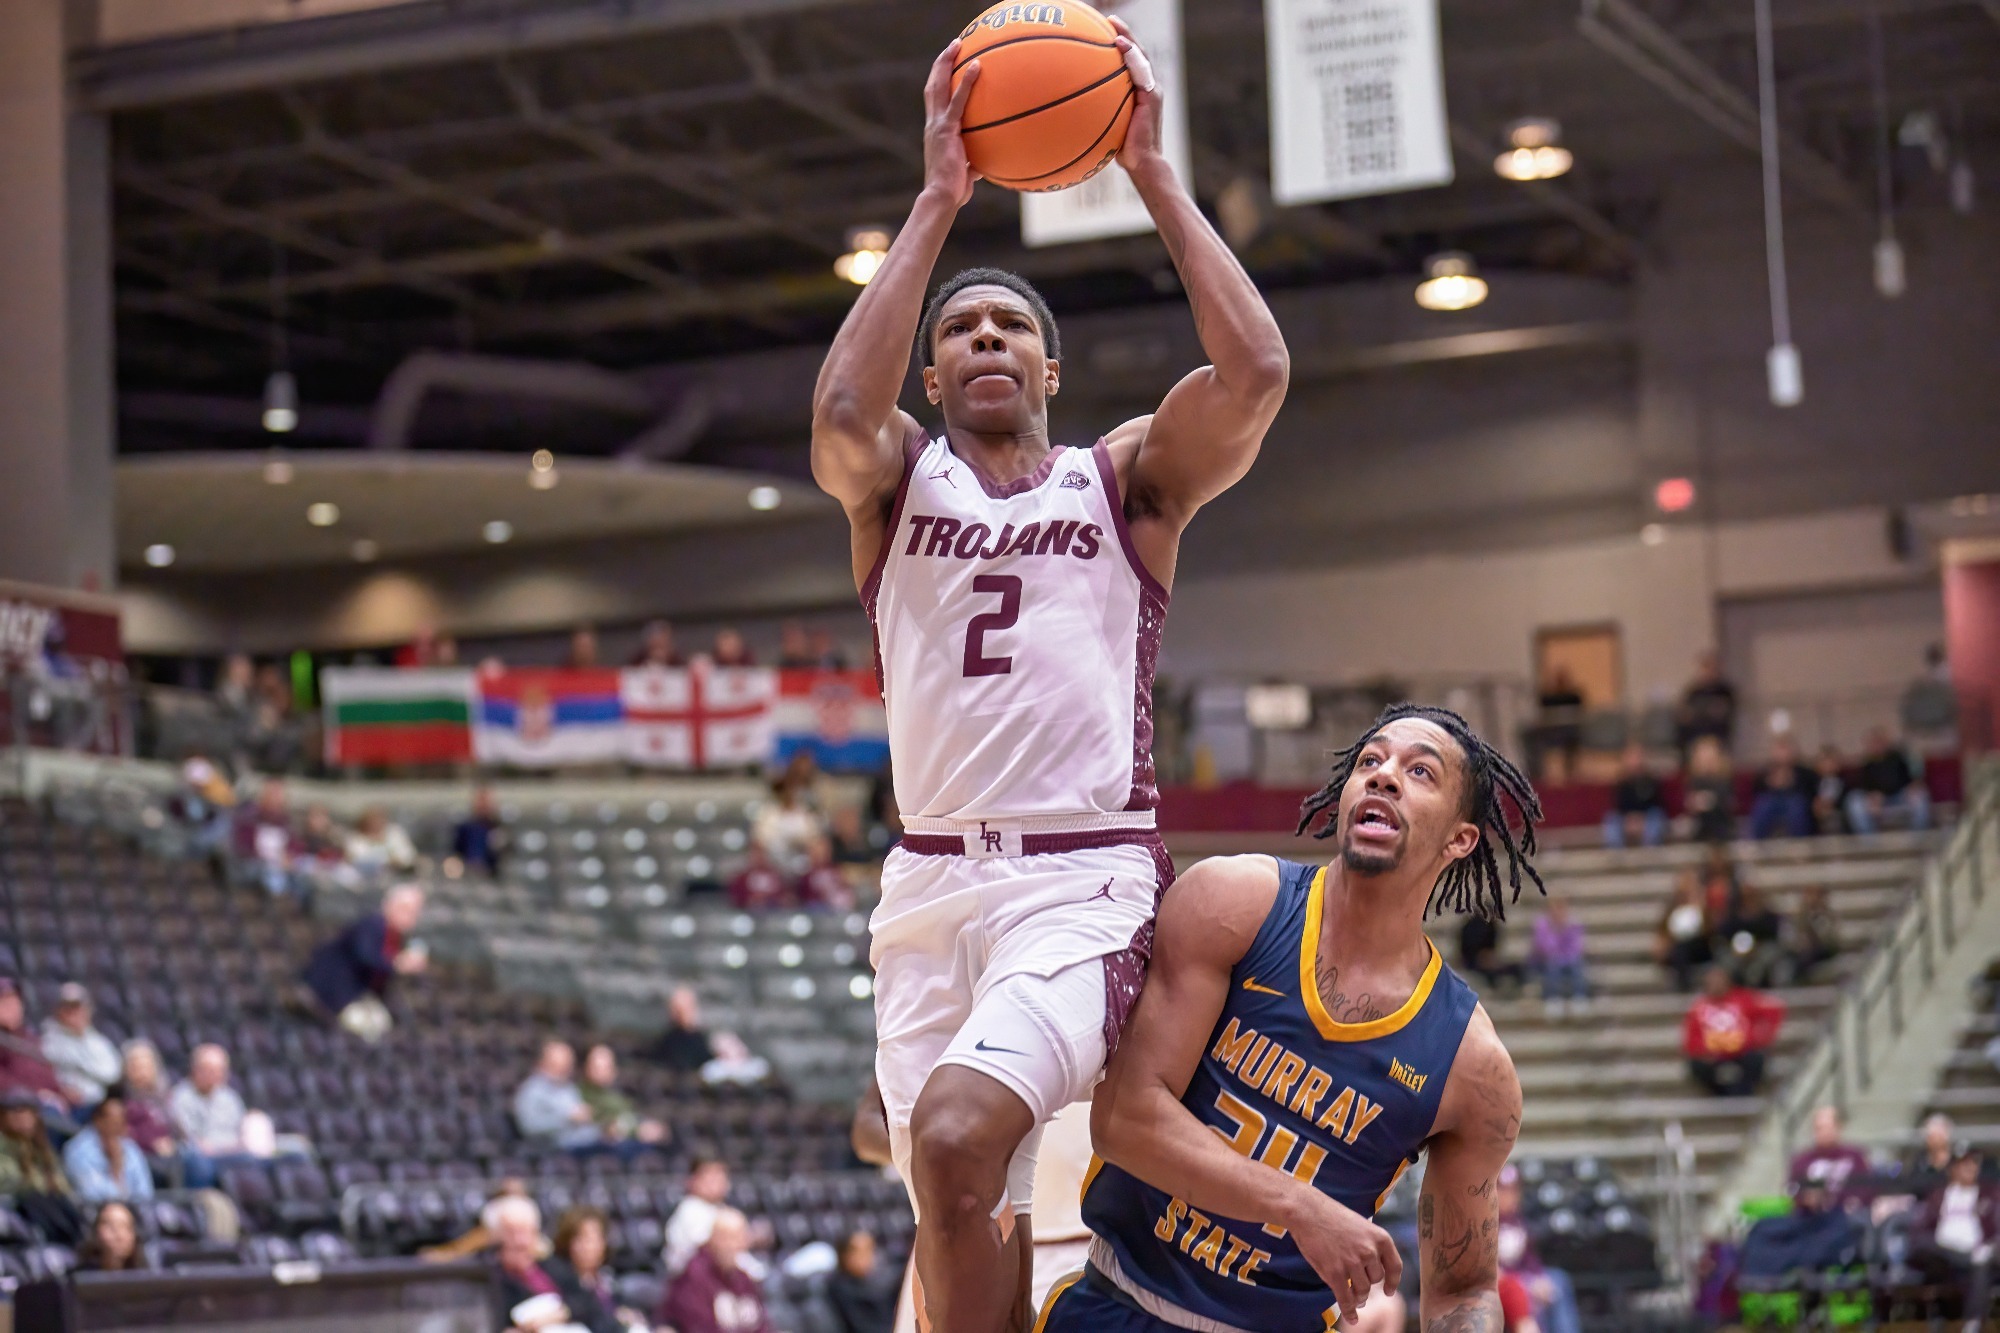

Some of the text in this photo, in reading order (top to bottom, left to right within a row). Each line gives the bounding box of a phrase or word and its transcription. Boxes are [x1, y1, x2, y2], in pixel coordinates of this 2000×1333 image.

[960, 4, 1065, 40] Wilso
[905, 515, 1104, 560] TROJANS
[963, 574, 1023, 677] 2
[980, 821, 1003, 852] LR
[1211, 1016, 1384, 1145] MURRAY
[1388, 1056, 1428, 1093] VALLEY
[1154, 1196, 1272, 1287] STATE
